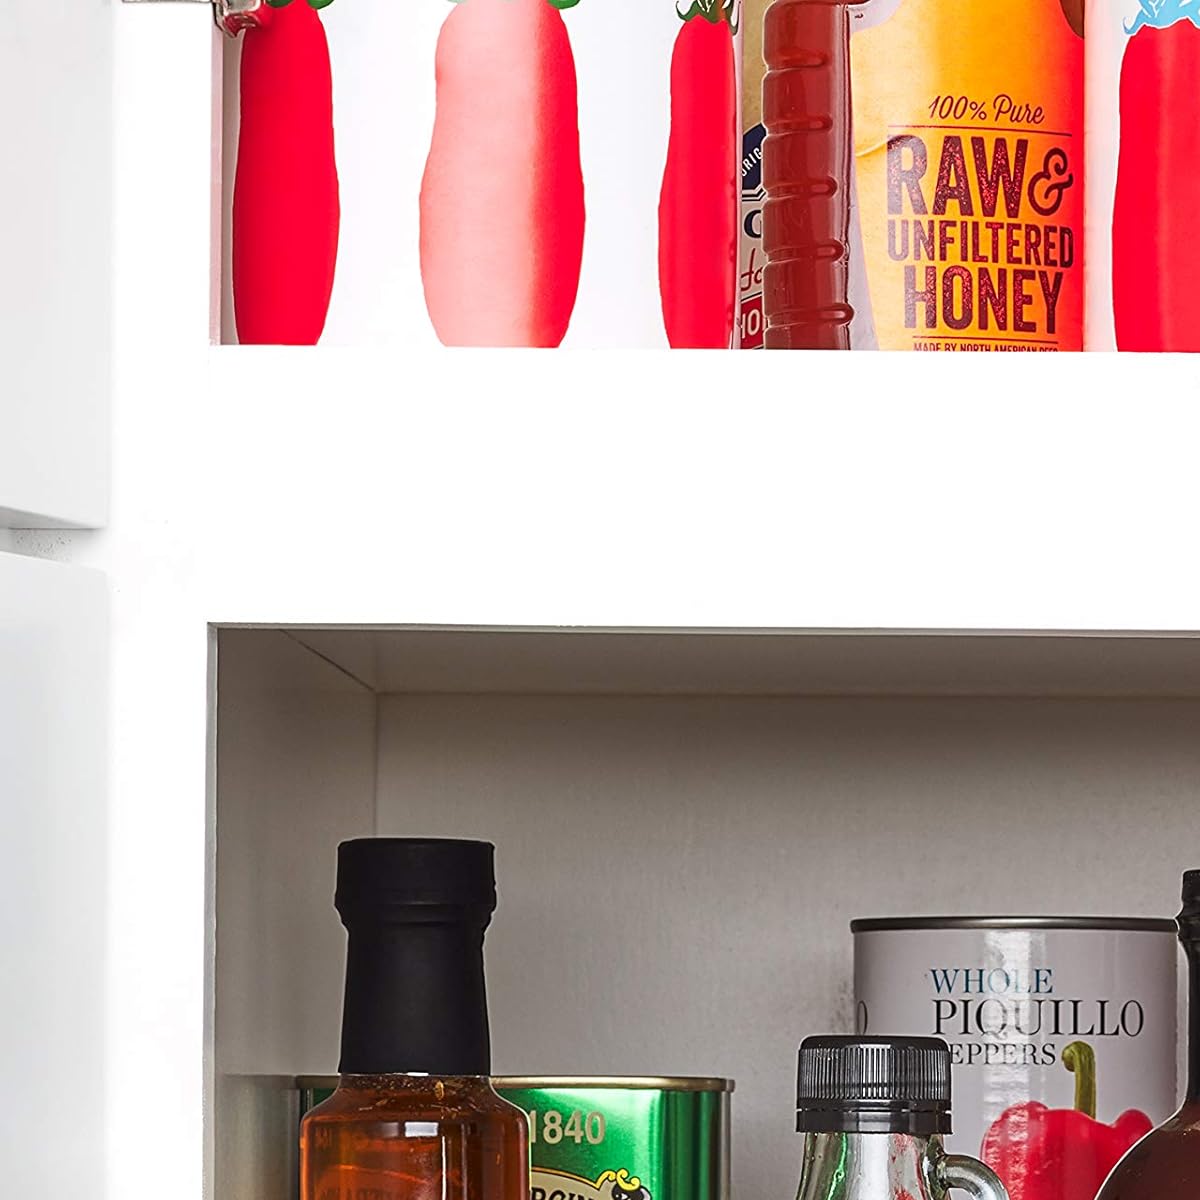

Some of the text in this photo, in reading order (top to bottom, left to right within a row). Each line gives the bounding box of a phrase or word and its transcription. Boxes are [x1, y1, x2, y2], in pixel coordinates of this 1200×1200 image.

[929, 94, 1044, 124] 100% Pure
[887, 134, 1073, 219] RAW &
[887, 219, 1073, 268] UNFILTERED
[904, 265, 1063, 334] HONEY
[930, 968, 1053, 994] WHOLE
[932, 999, 1145, 1040] PIQUILLO
[950, 1043, 1056, 1065] EPPERS
[529, 1110, 606, 1145] 1840
